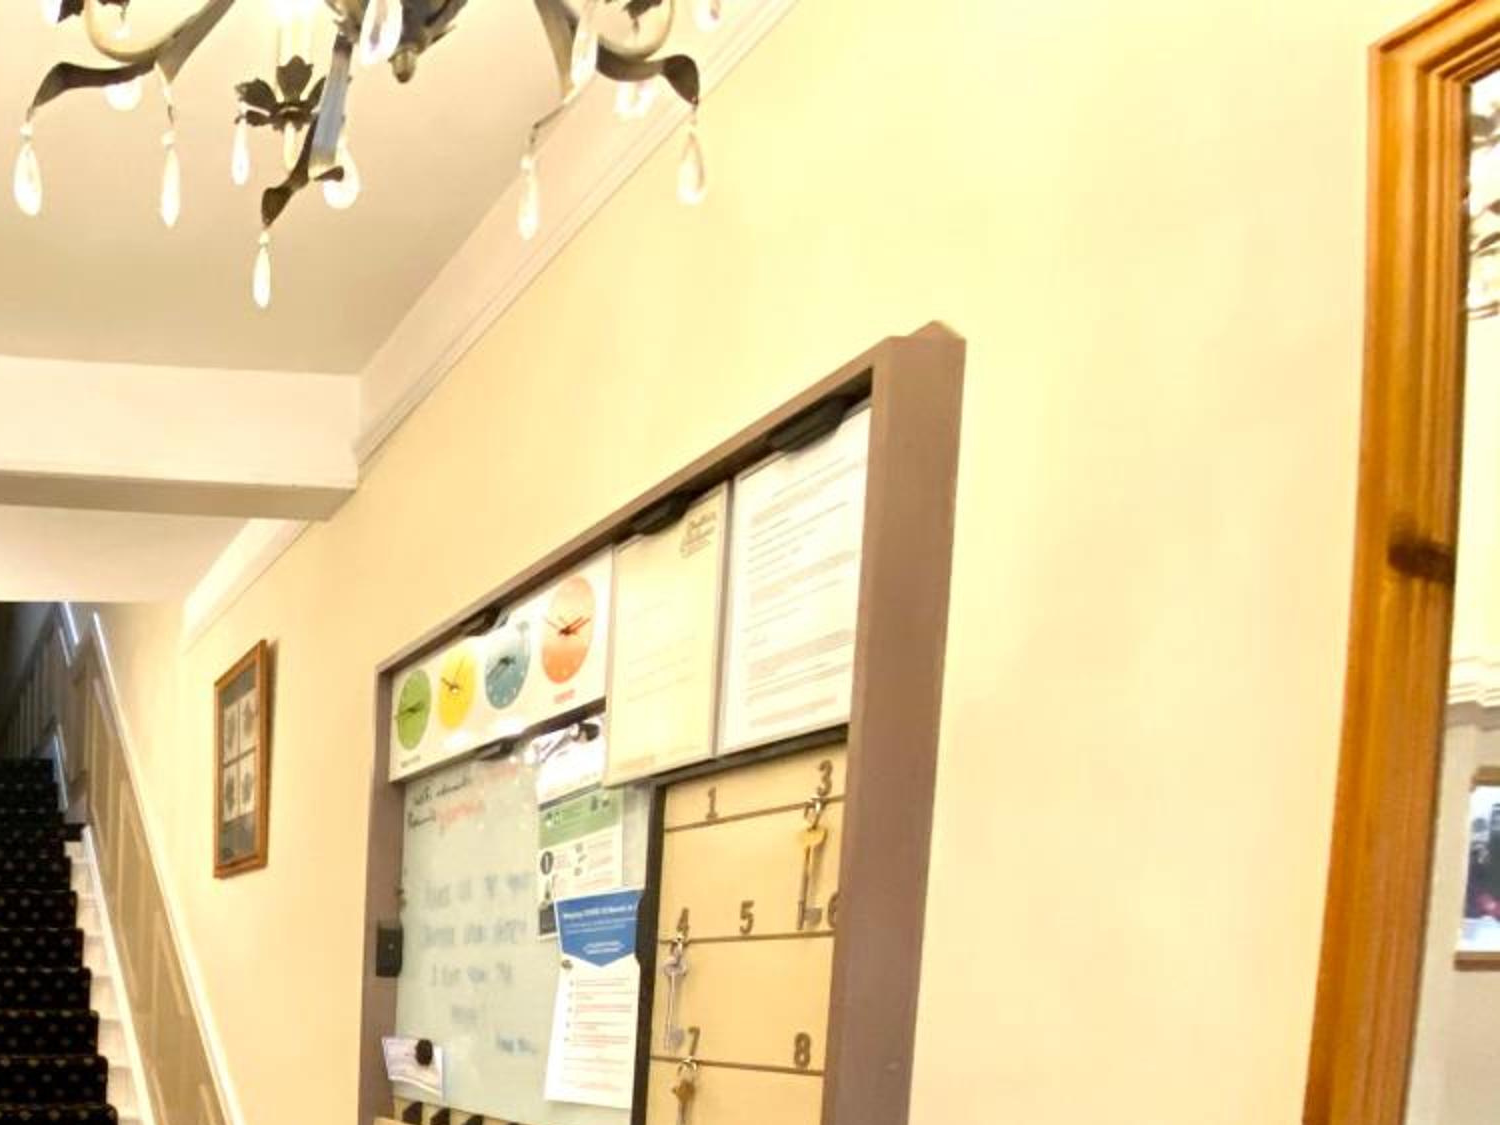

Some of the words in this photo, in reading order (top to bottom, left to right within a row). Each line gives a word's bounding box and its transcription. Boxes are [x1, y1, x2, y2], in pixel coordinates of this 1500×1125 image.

[816, 760, 833, 798] 3
[705, 787, 718, 822] 1
[676, 906, 690, 937] 4
[739, 900, 755, 934] 5
[687, 1026, 701, 1058] 7
[794, 1033, 811, 1069] 8
